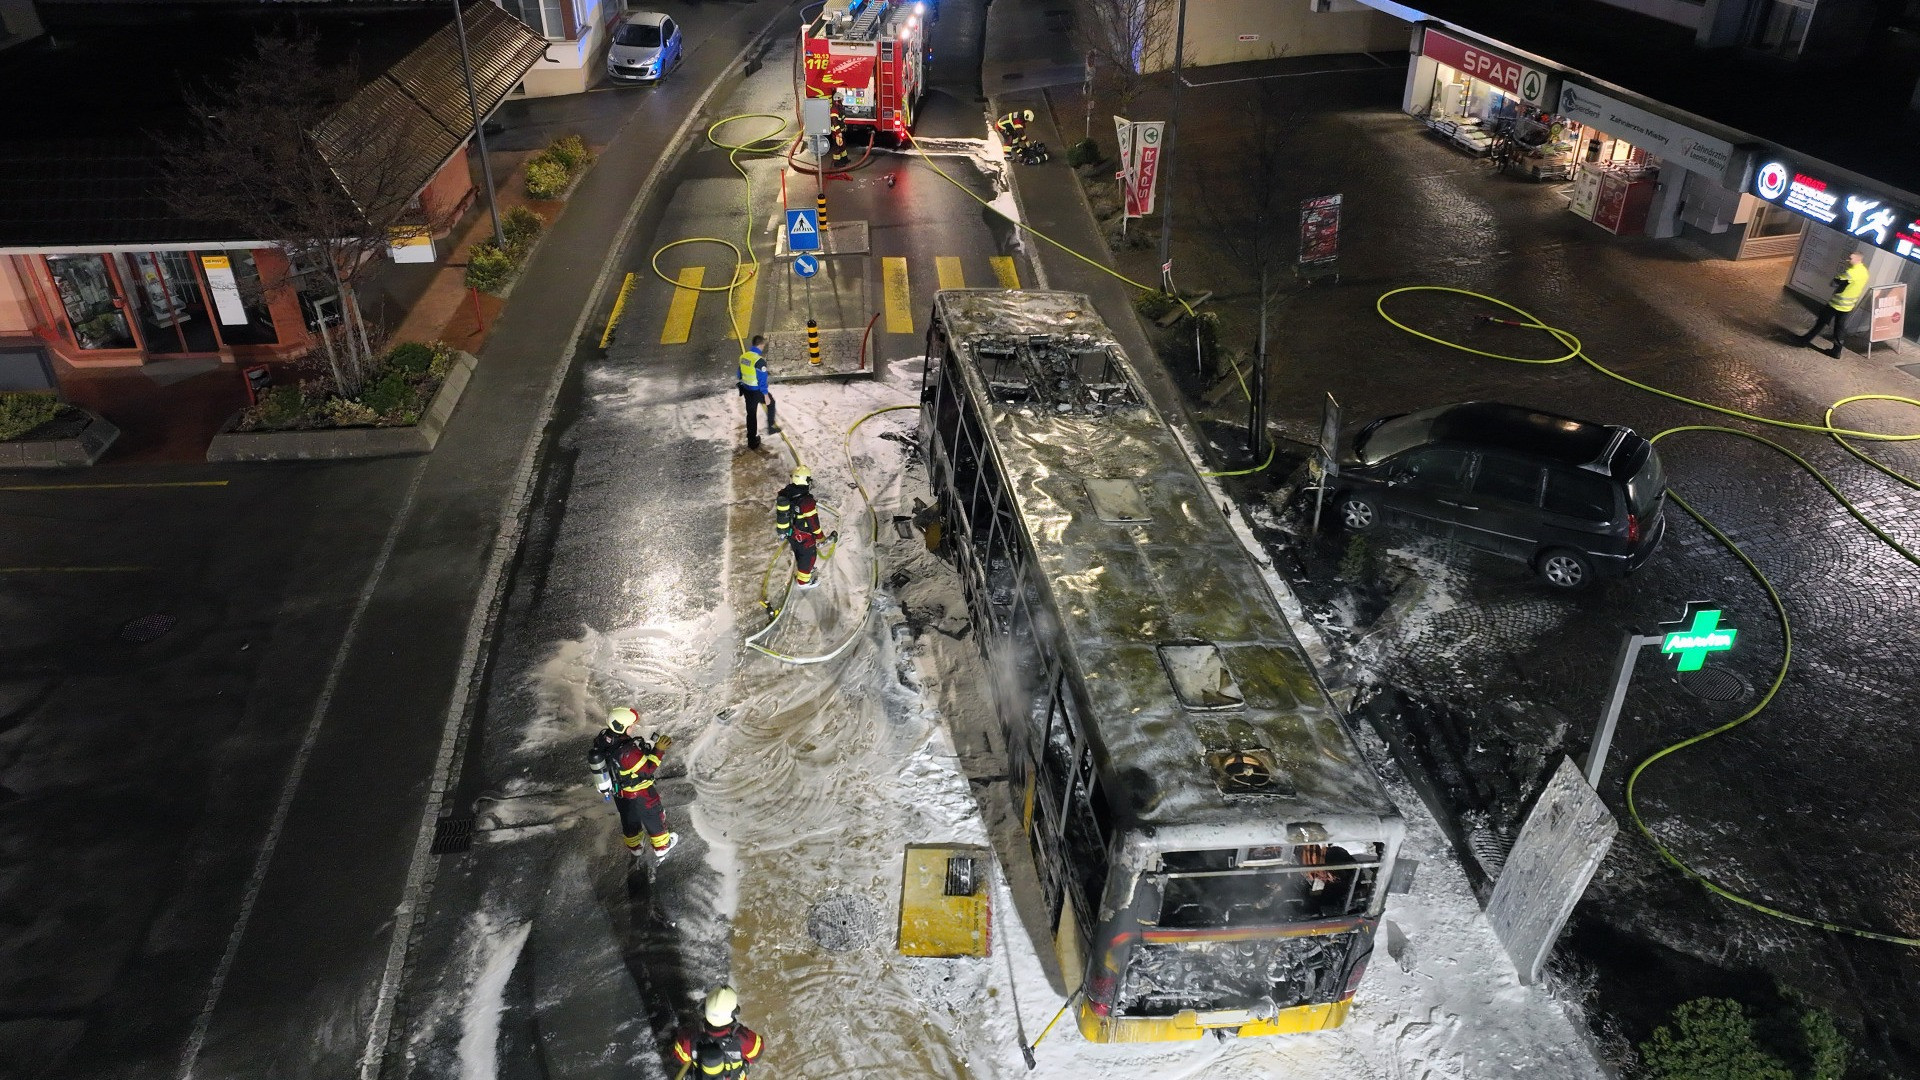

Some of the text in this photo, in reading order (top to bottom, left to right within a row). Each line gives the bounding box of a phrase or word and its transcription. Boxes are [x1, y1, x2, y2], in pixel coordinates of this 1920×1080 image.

[807, 59, 829, 69] 118
[1463, 50, 1520, 90] SPAR
[1139, 150, 1155, 198] SPAR
